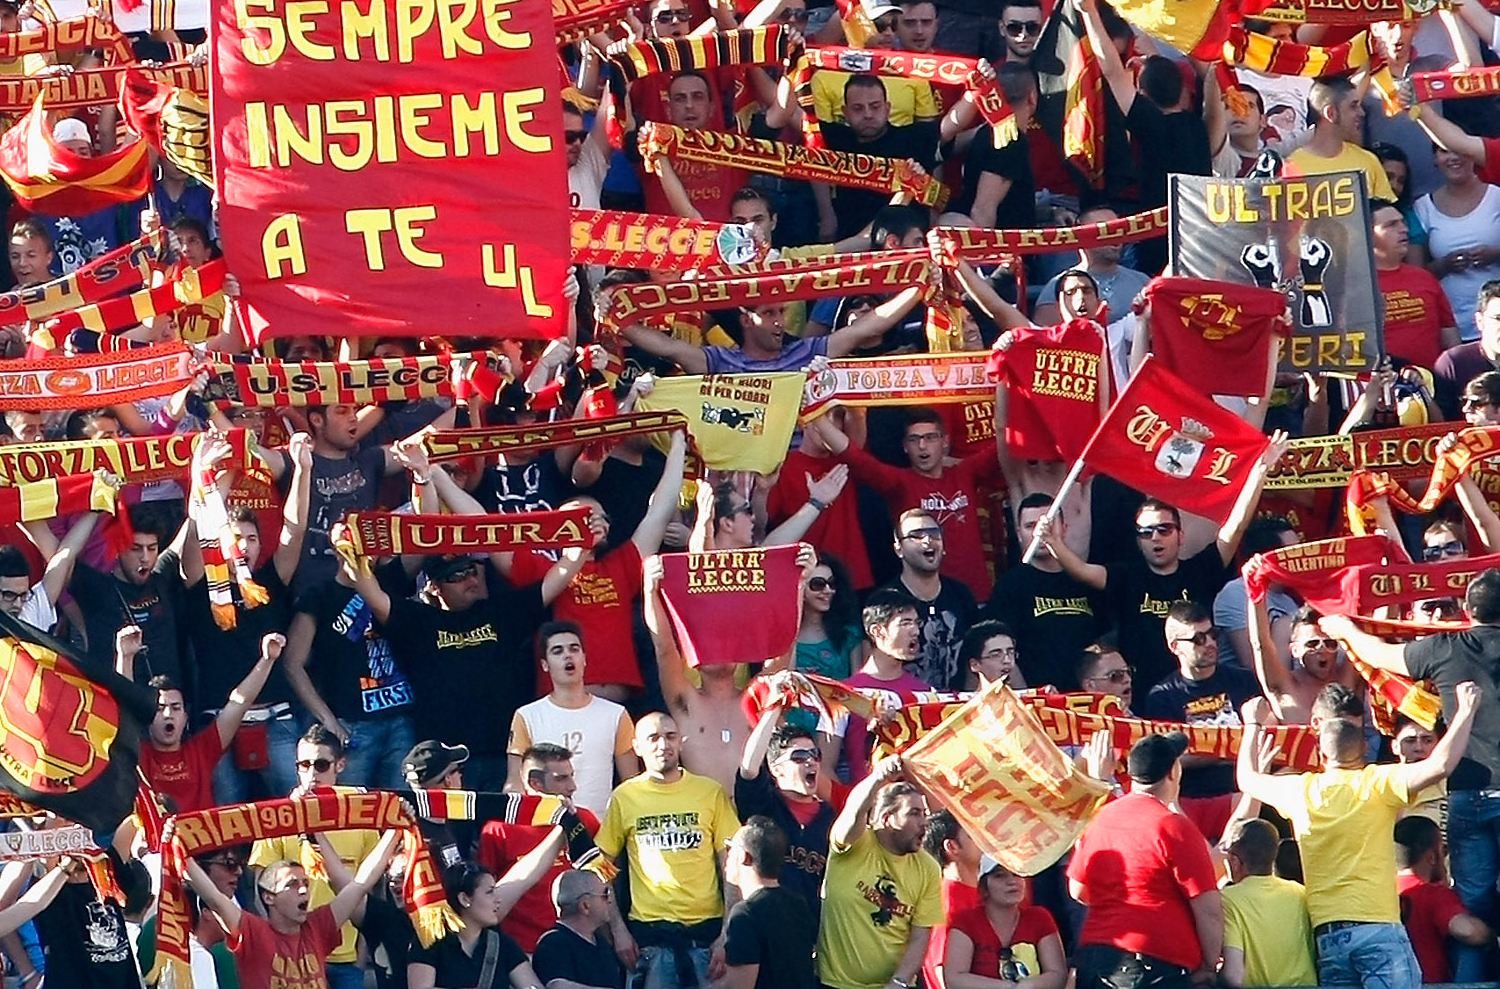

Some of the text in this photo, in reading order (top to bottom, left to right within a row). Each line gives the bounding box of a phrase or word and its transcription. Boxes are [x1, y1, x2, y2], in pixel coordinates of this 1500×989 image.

[245, 87, 553, 172] INSIEME
[1206, 177, 1357, 225] ULTRAS
[261, 205, 444, 280] A TE
[1035, 351, 1098, 378] ULTRA
[1032, 371, 1097, 398] LECCE
[687, 570, 766, 587] LECCE
